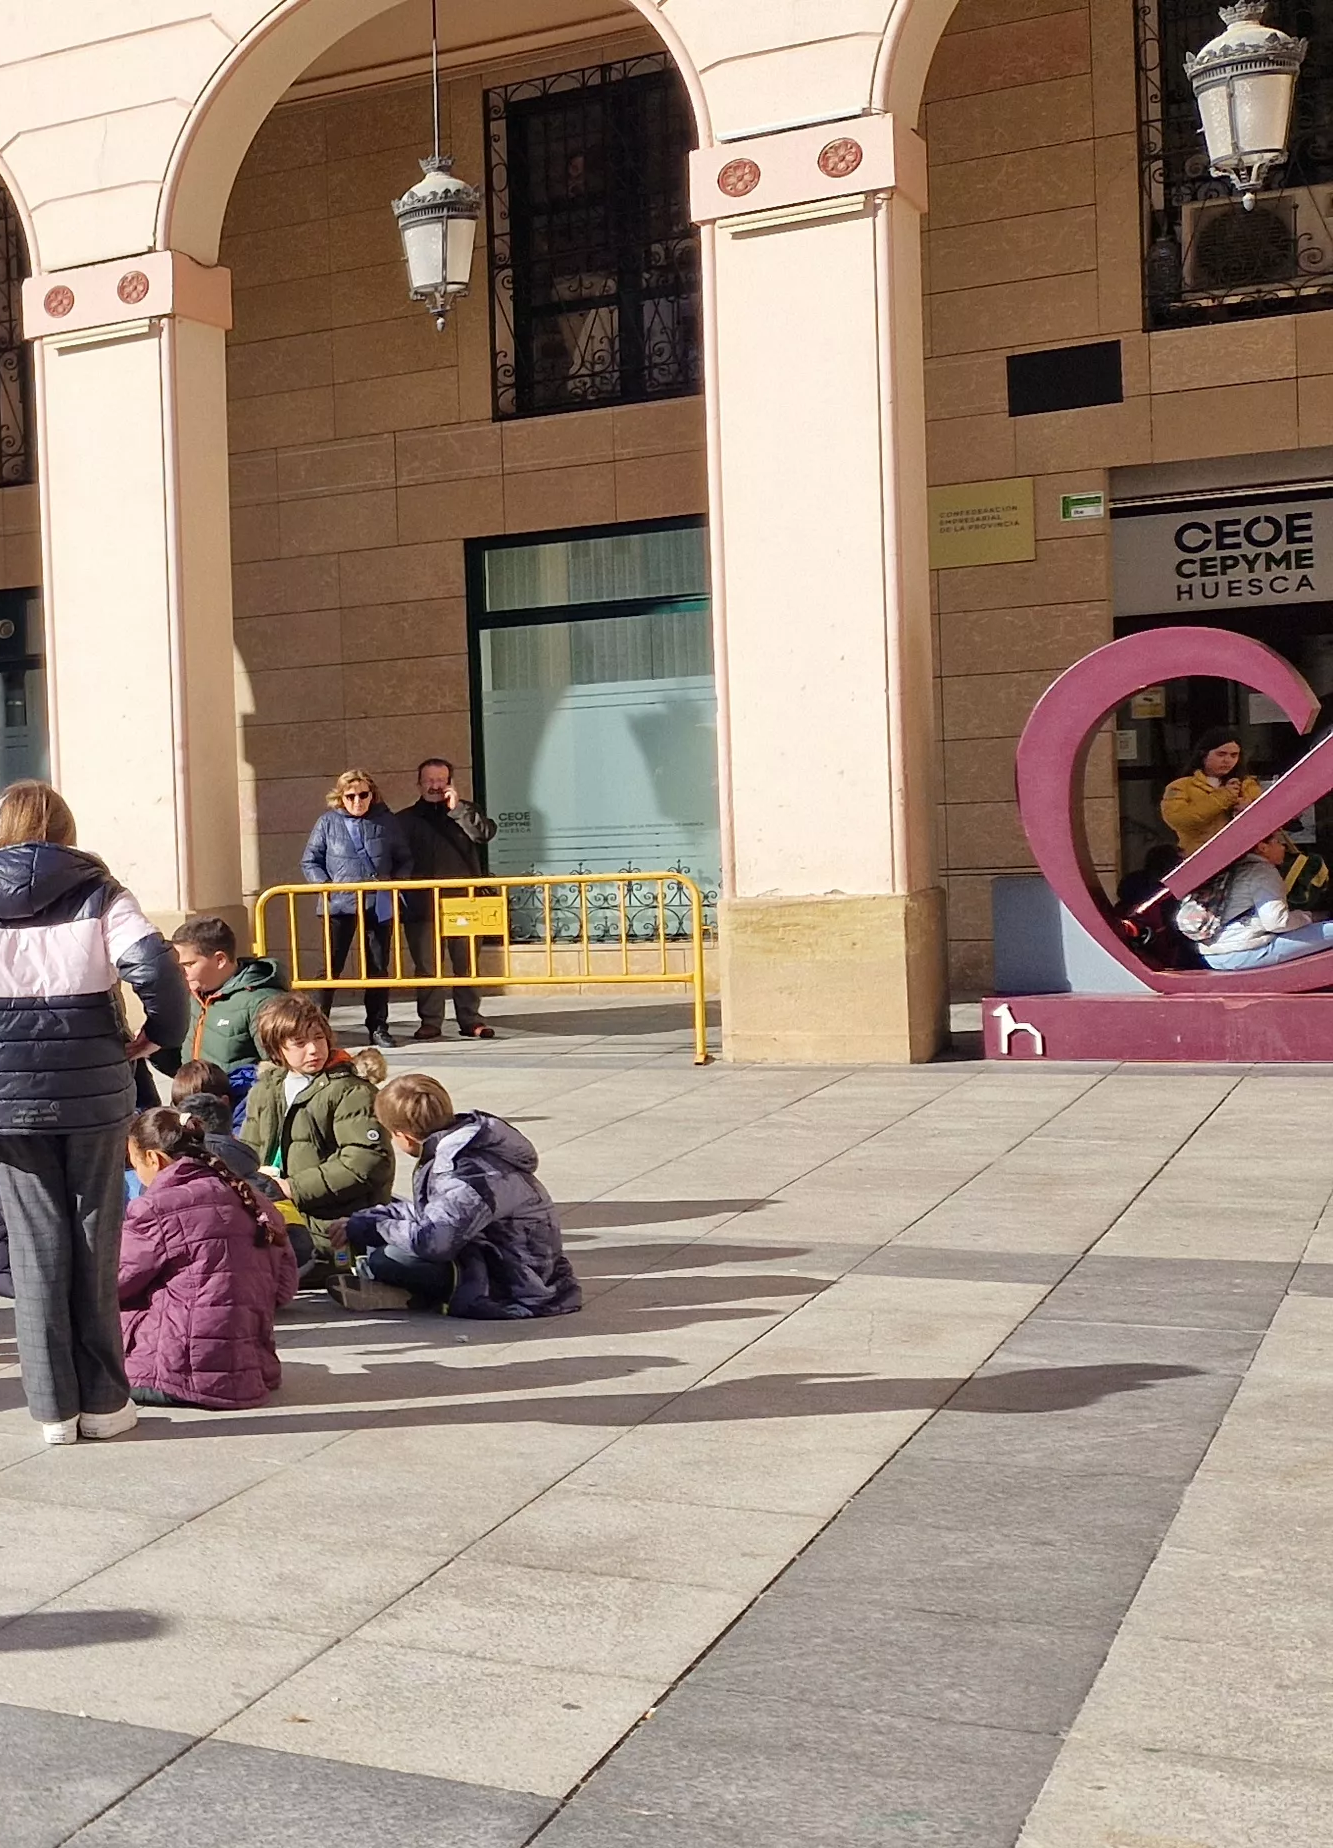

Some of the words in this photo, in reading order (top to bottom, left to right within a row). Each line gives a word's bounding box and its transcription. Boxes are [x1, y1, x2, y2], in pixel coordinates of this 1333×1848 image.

[1174, 512, 1314, 554] CEOE
[1175, 548, 1314, 579] CEPYME
[1176, 574, 1316, 601] HUESCA
[498, 811, 531, 821] CEOE
